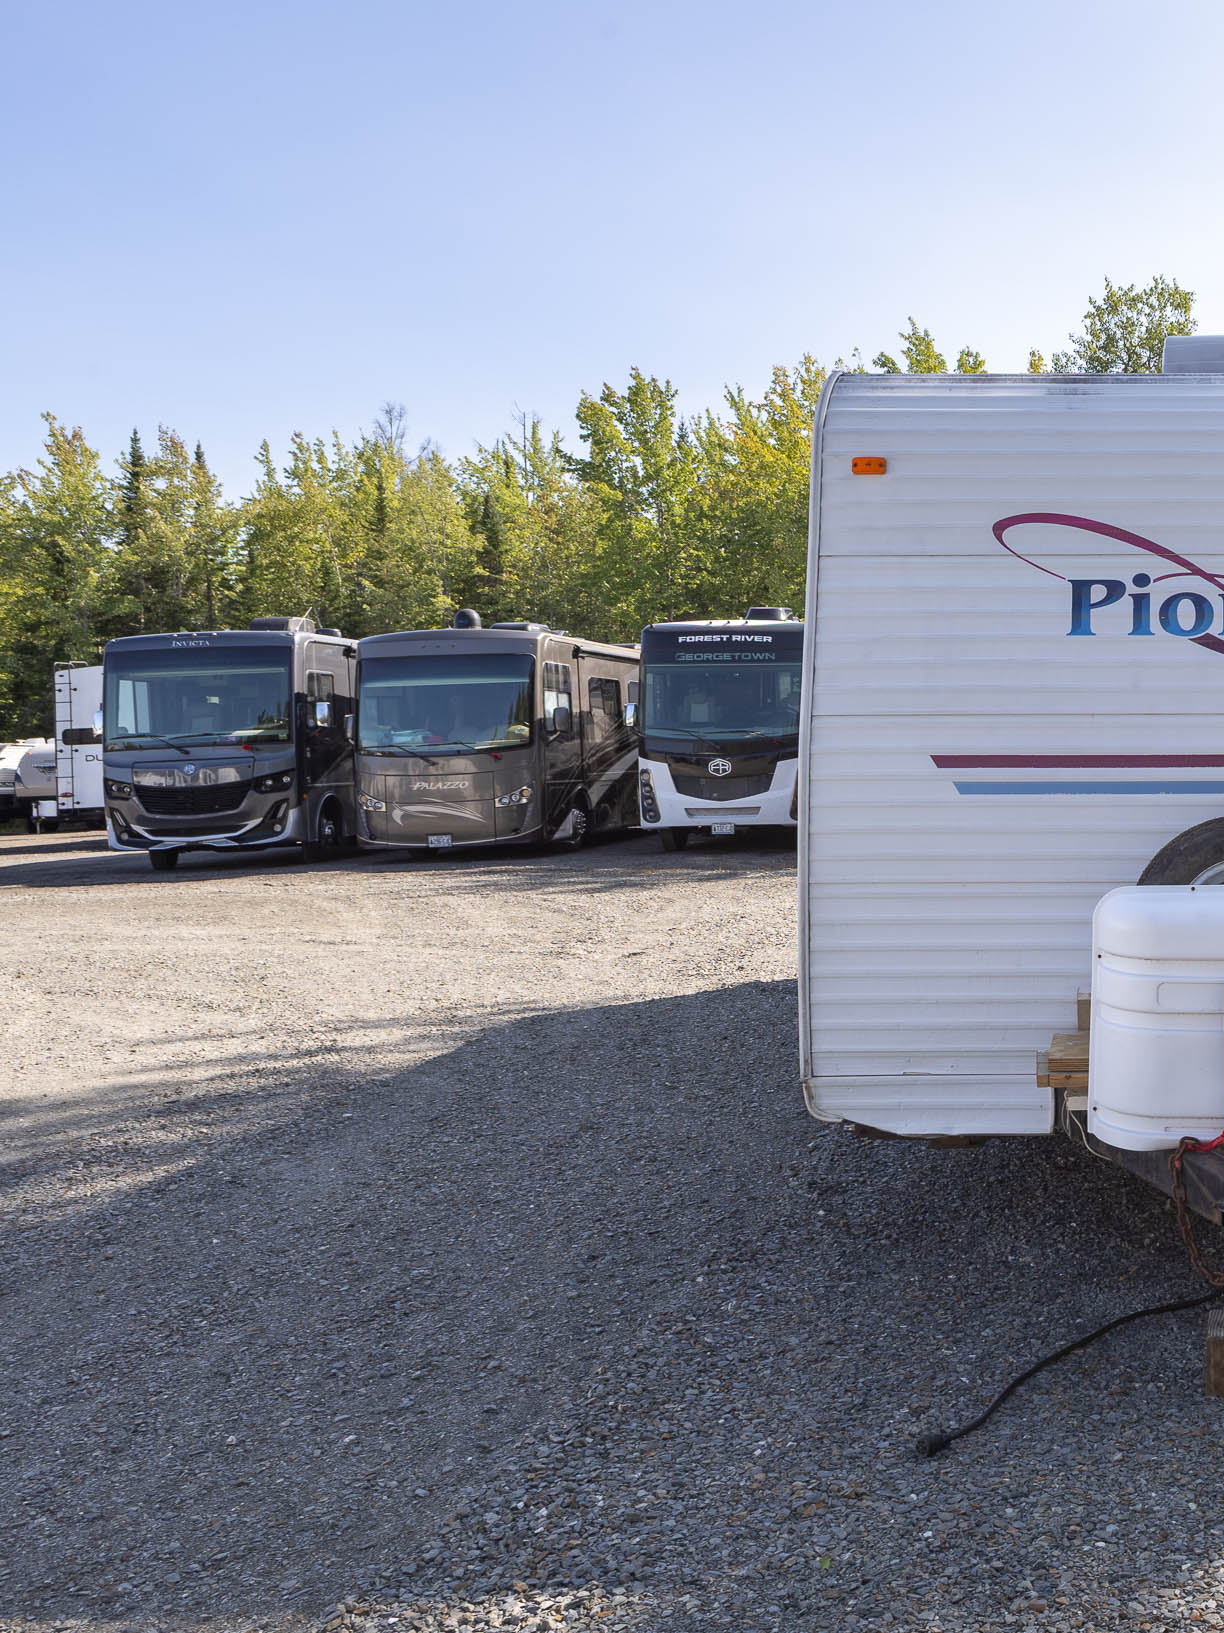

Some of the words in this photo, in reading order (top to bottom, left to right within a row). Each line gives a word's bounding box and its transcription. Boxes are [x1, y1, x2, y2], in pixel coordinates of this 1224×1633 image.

[678, 635, 729, 643] FOREST
[675, 652, 776, 661] GEORGETOWN
[412, 781, 469, 790] PALAZZO
